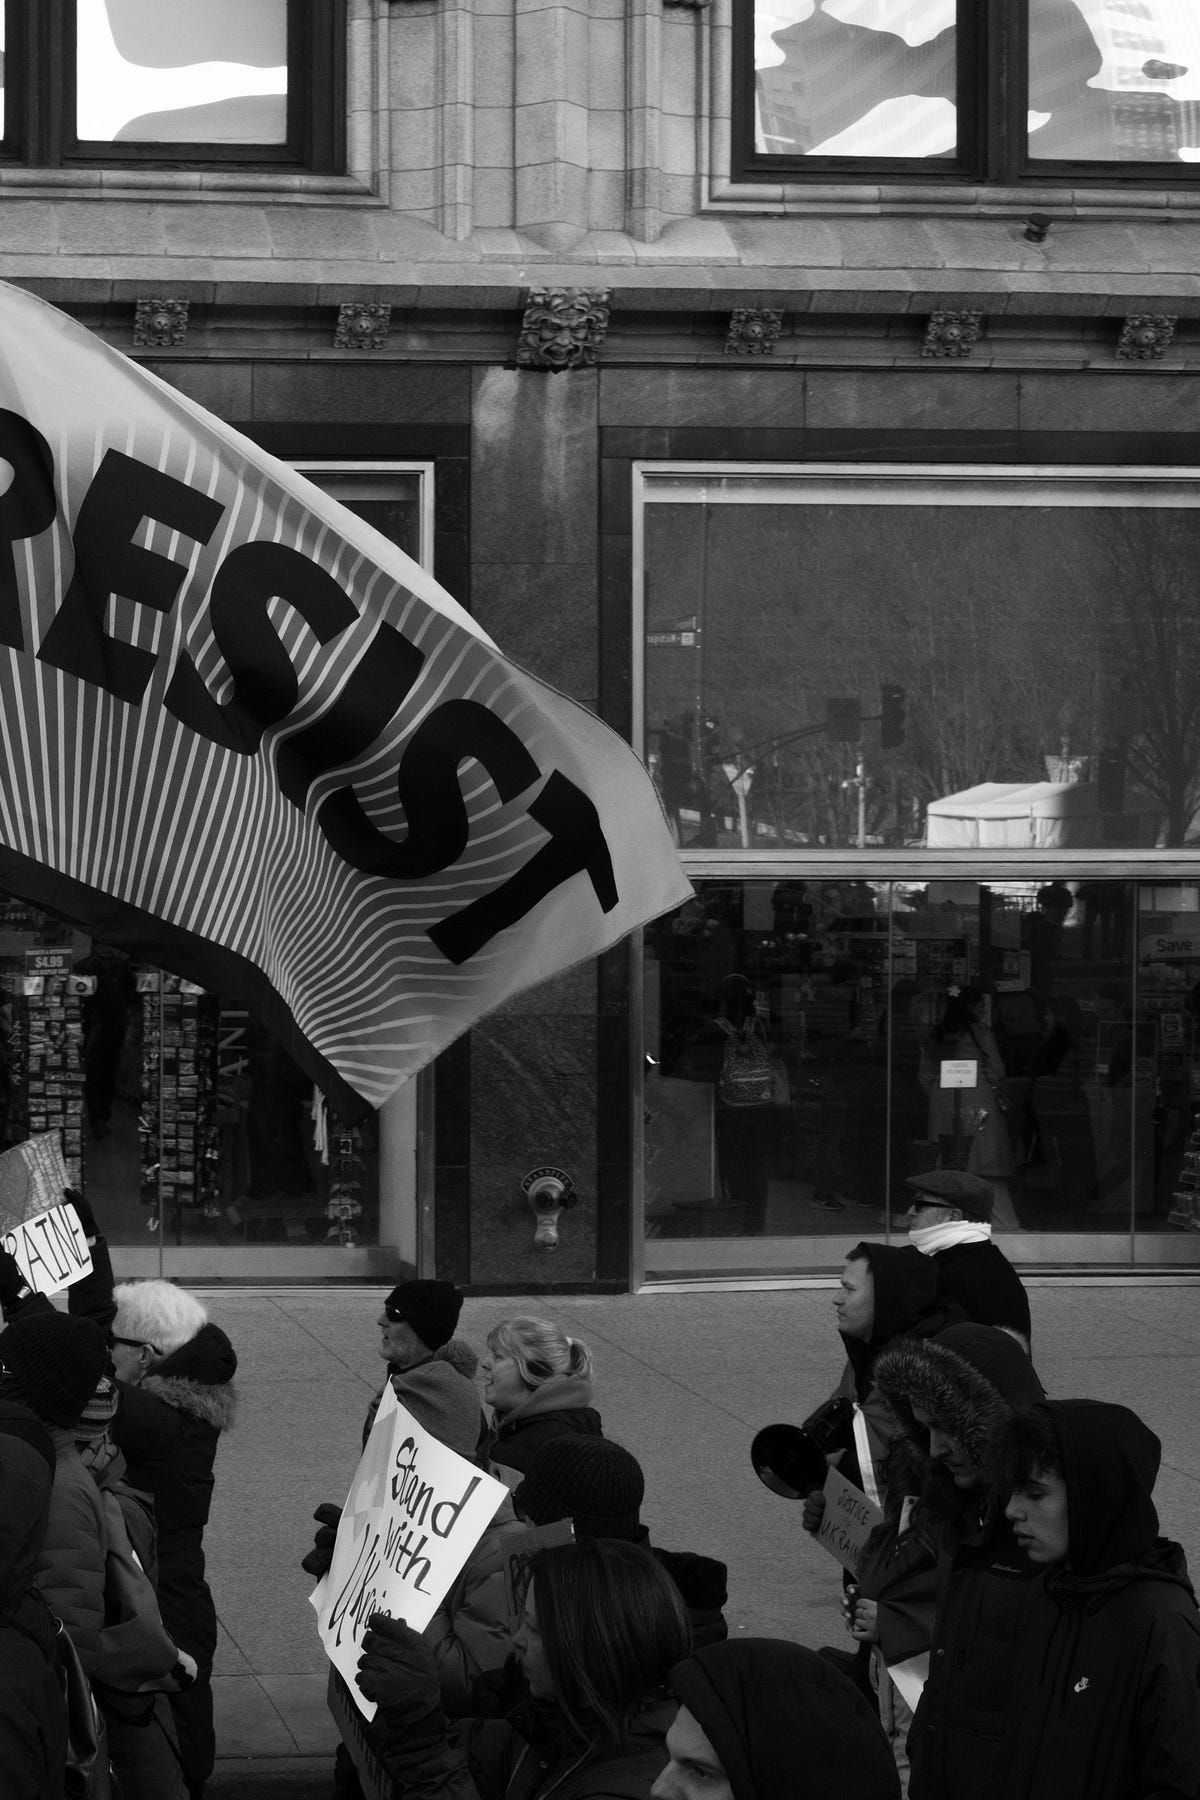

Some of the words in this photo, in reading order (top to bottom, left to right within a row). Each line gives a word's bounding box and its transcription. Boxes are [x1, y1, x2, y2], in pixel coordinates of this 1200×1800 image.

[1157, 938, 1193, 953] Save
[34, 955, 64, 969] $4.99
[391, 1436, 483, 1540] Stand
